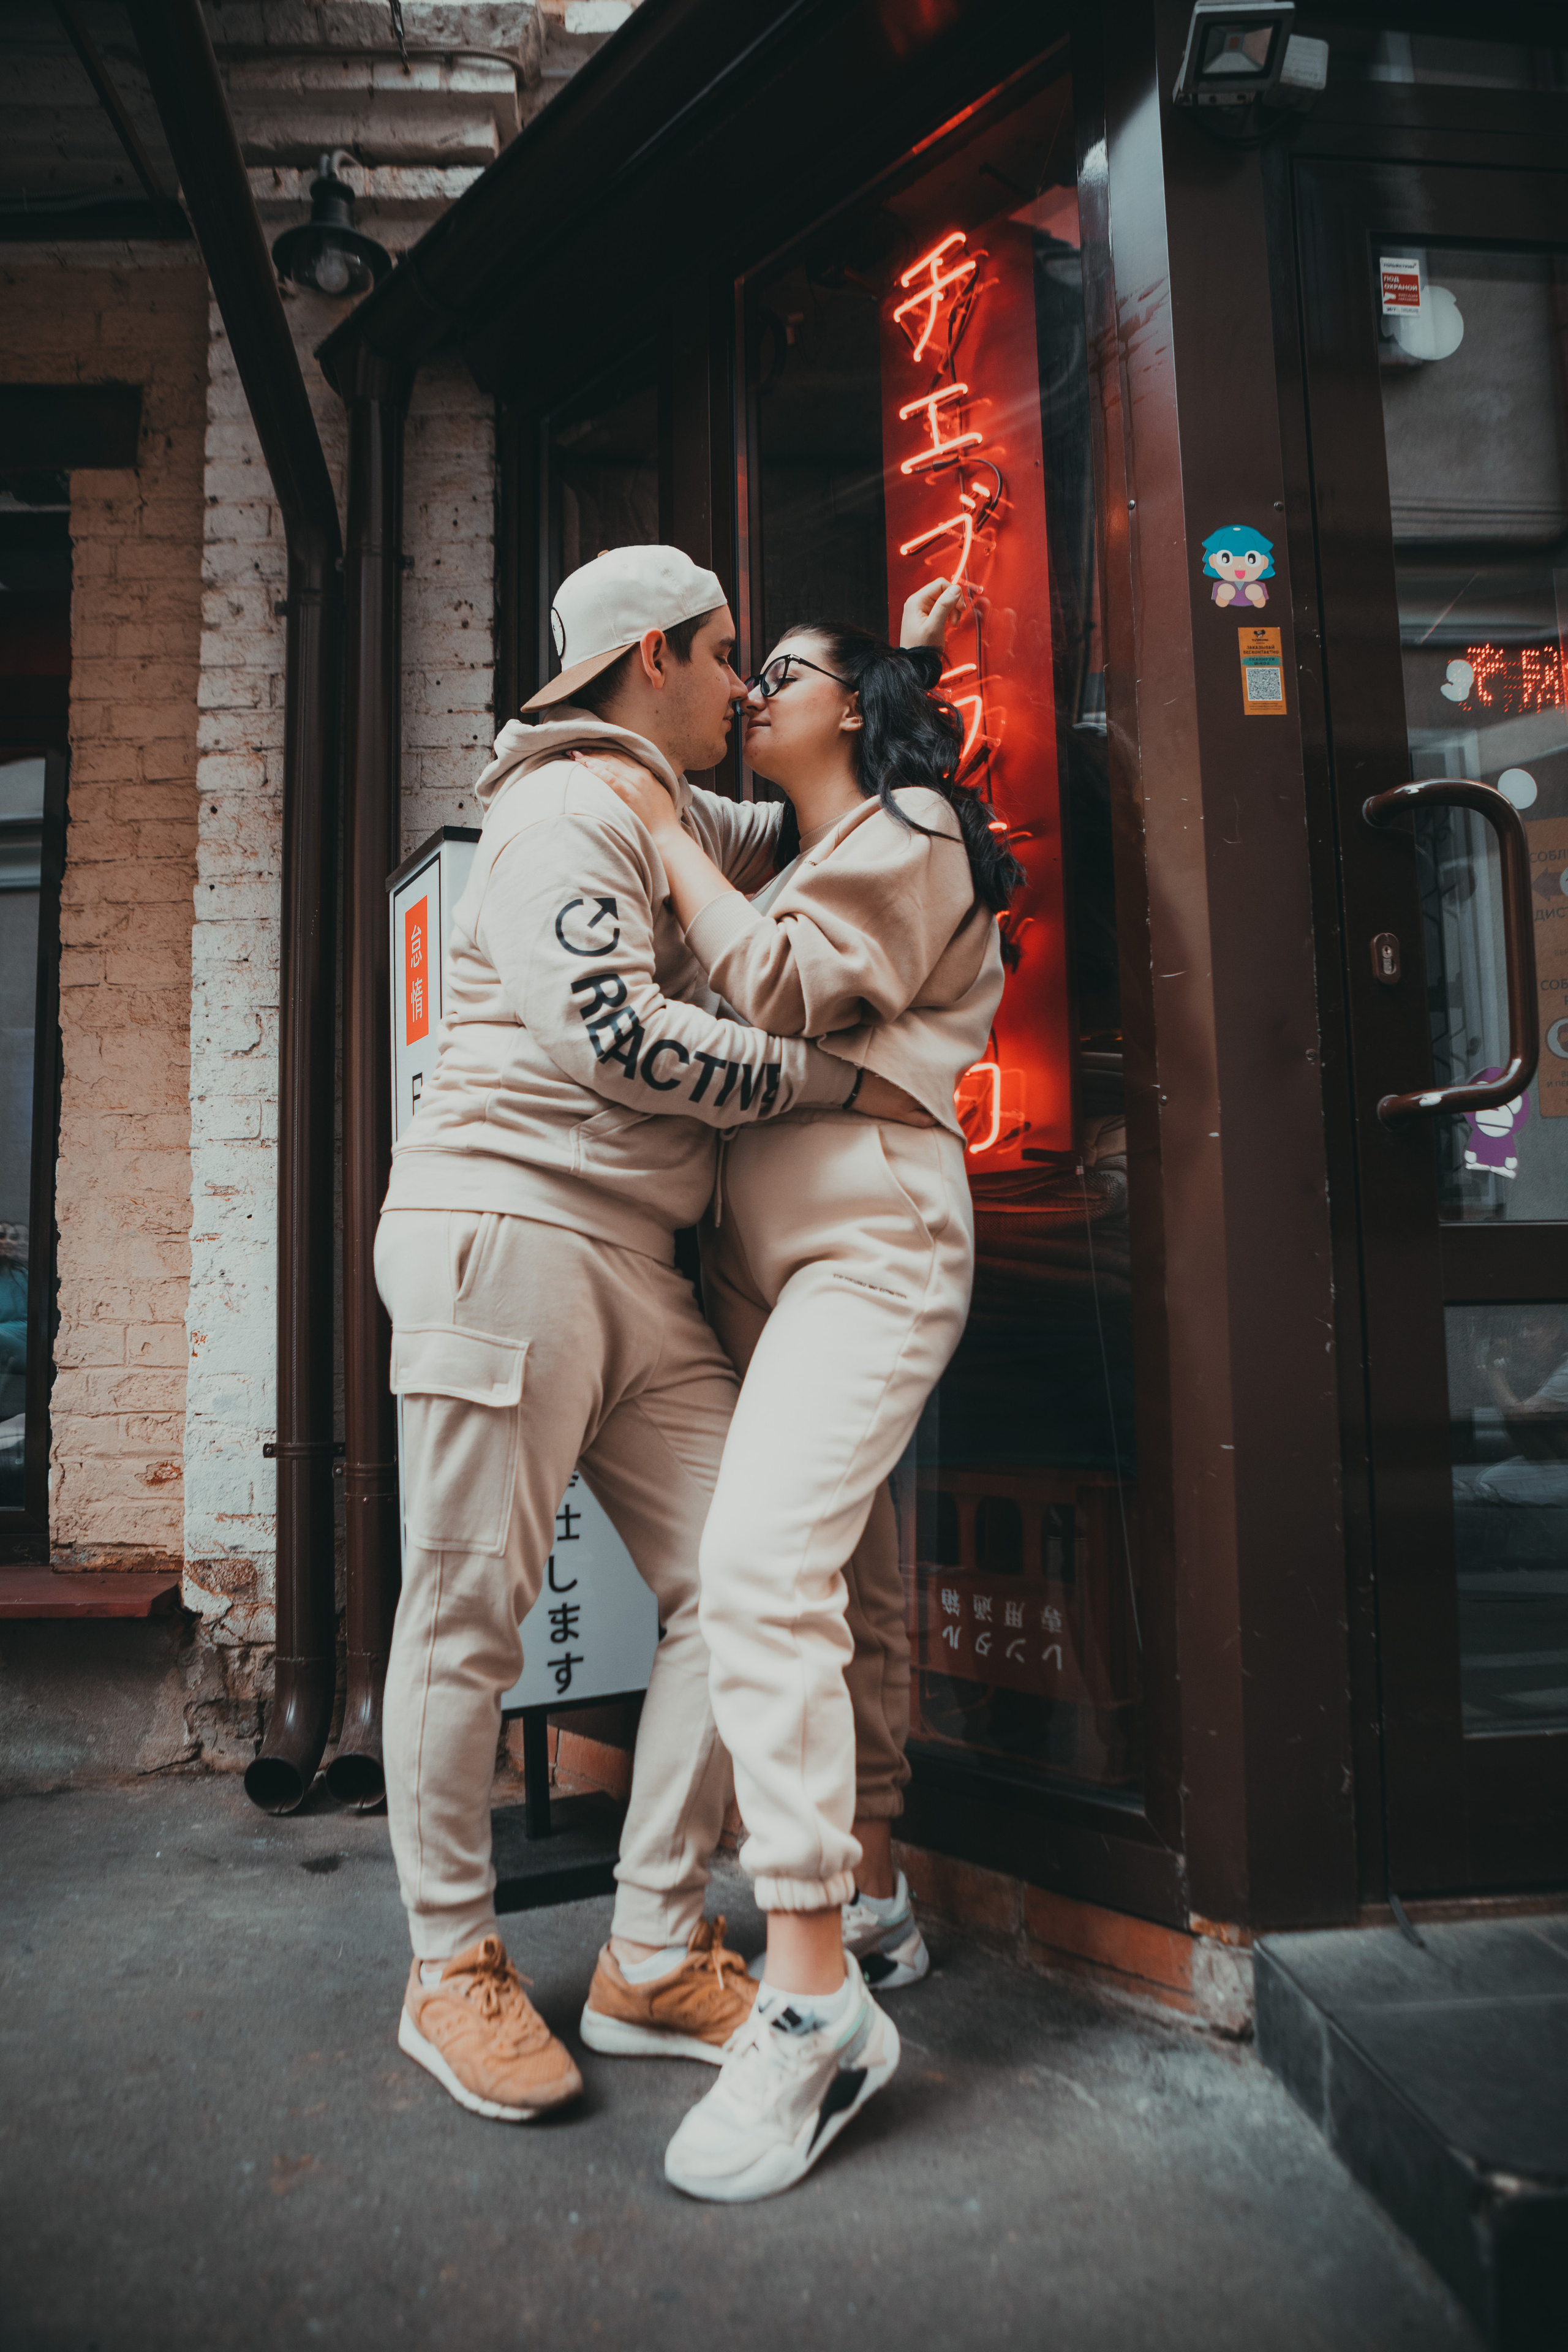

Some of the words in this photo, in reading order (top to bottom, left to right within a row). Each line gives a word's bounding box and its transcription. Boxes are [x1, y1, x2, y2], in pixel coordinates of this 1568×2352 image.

[1384, 282, 1417, 292] ОХРАНОЙ
[1529, 848, 1568, 863] СОБЛ
[1534, 906, 1568, 922] ДИС
